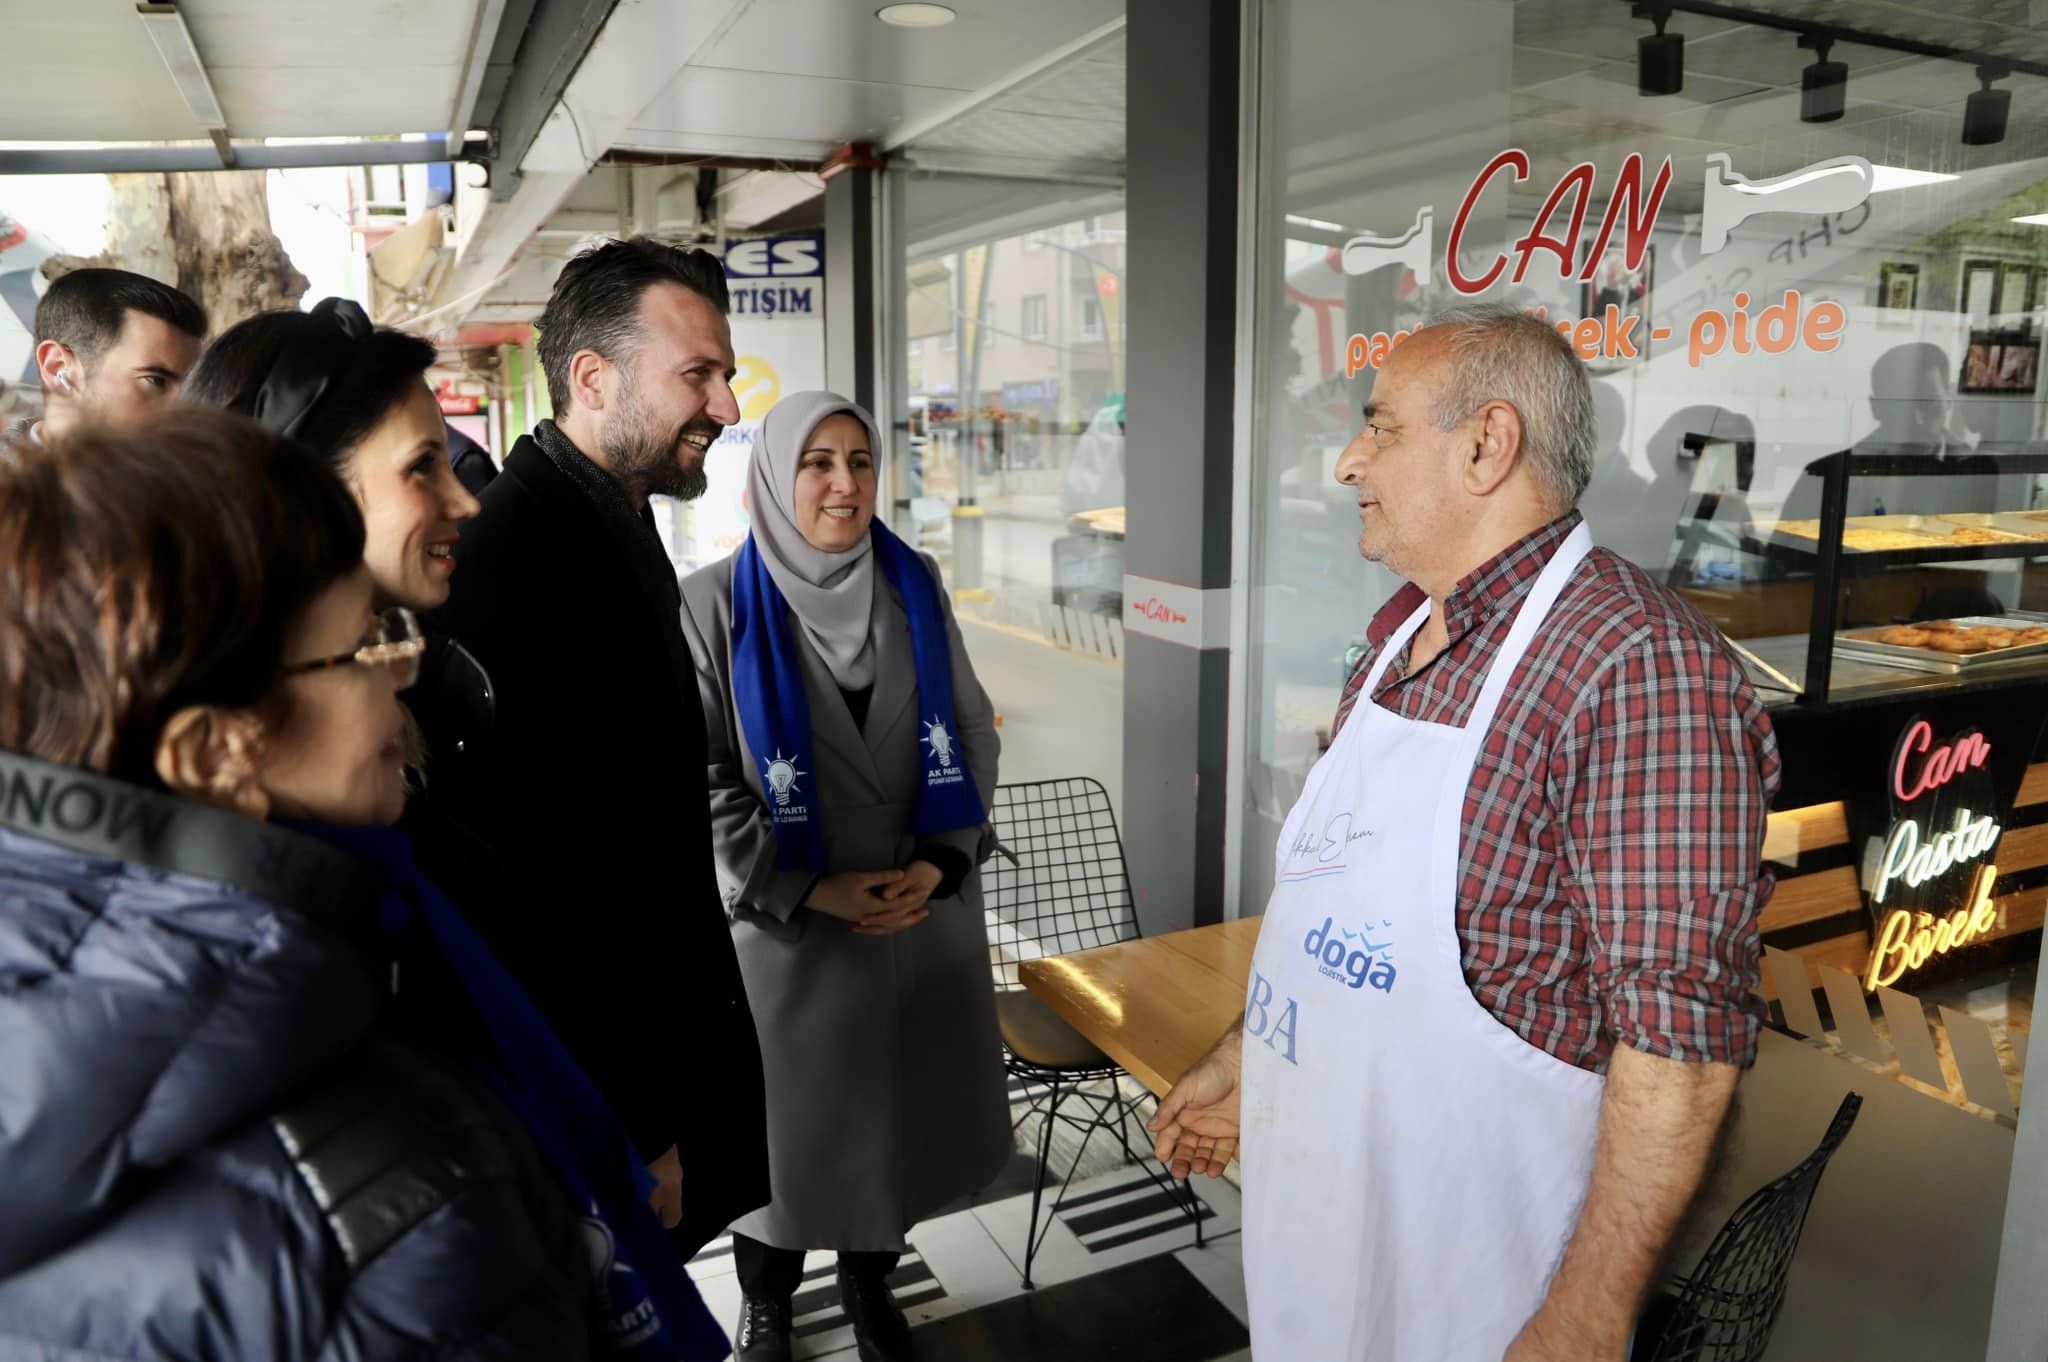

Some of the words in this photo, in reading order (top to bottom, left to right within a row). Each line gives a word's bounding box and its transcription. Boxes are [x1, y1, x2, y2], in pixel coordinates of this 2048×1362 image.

[722, 240, 819, 275] ES
[1445, 148, 1674, 294] CAN
[730, 281, 812, 319] TİŞİM
[1687, 289, 1845, 368] pide
[1894, 721, 1991, 801] Can
[0, 764, 177, 850] NOW
[1874, 808, 2000, 904] Pasta
[1866, 864, 1998, 992] Börek
